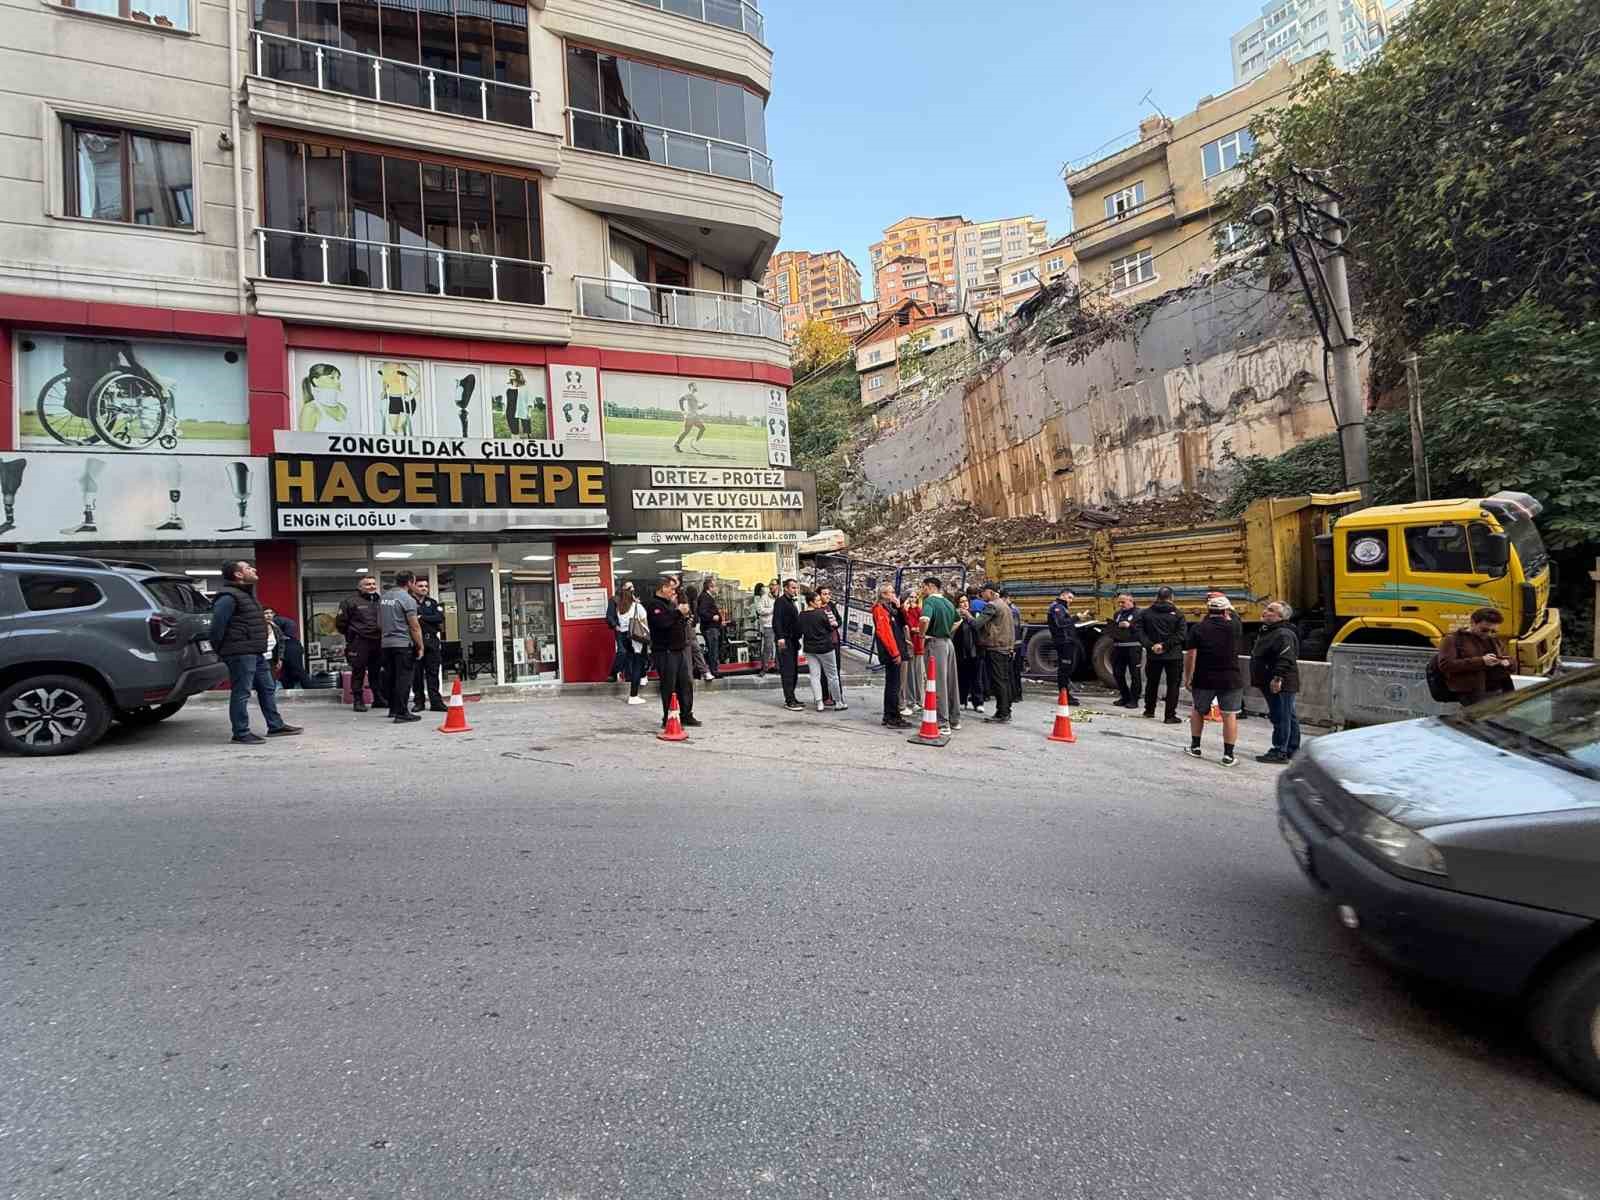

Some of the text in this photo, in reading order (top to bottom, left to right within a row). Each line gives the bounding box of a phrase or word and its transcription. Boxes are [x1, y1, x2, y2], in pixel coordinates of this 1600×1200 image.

[328, 436, 466, 457] ZONGULDAK
[274, 460, 606, 504] HACETTEPE
[653, 470, 707, 485] ORTEZ
[722, 471, 782, 486] PROTEZ
[635, 492, 802, 508] YAPIM VE UYGULAMA
[665, 531, 797, 542] www.hacettepemedikal.com
